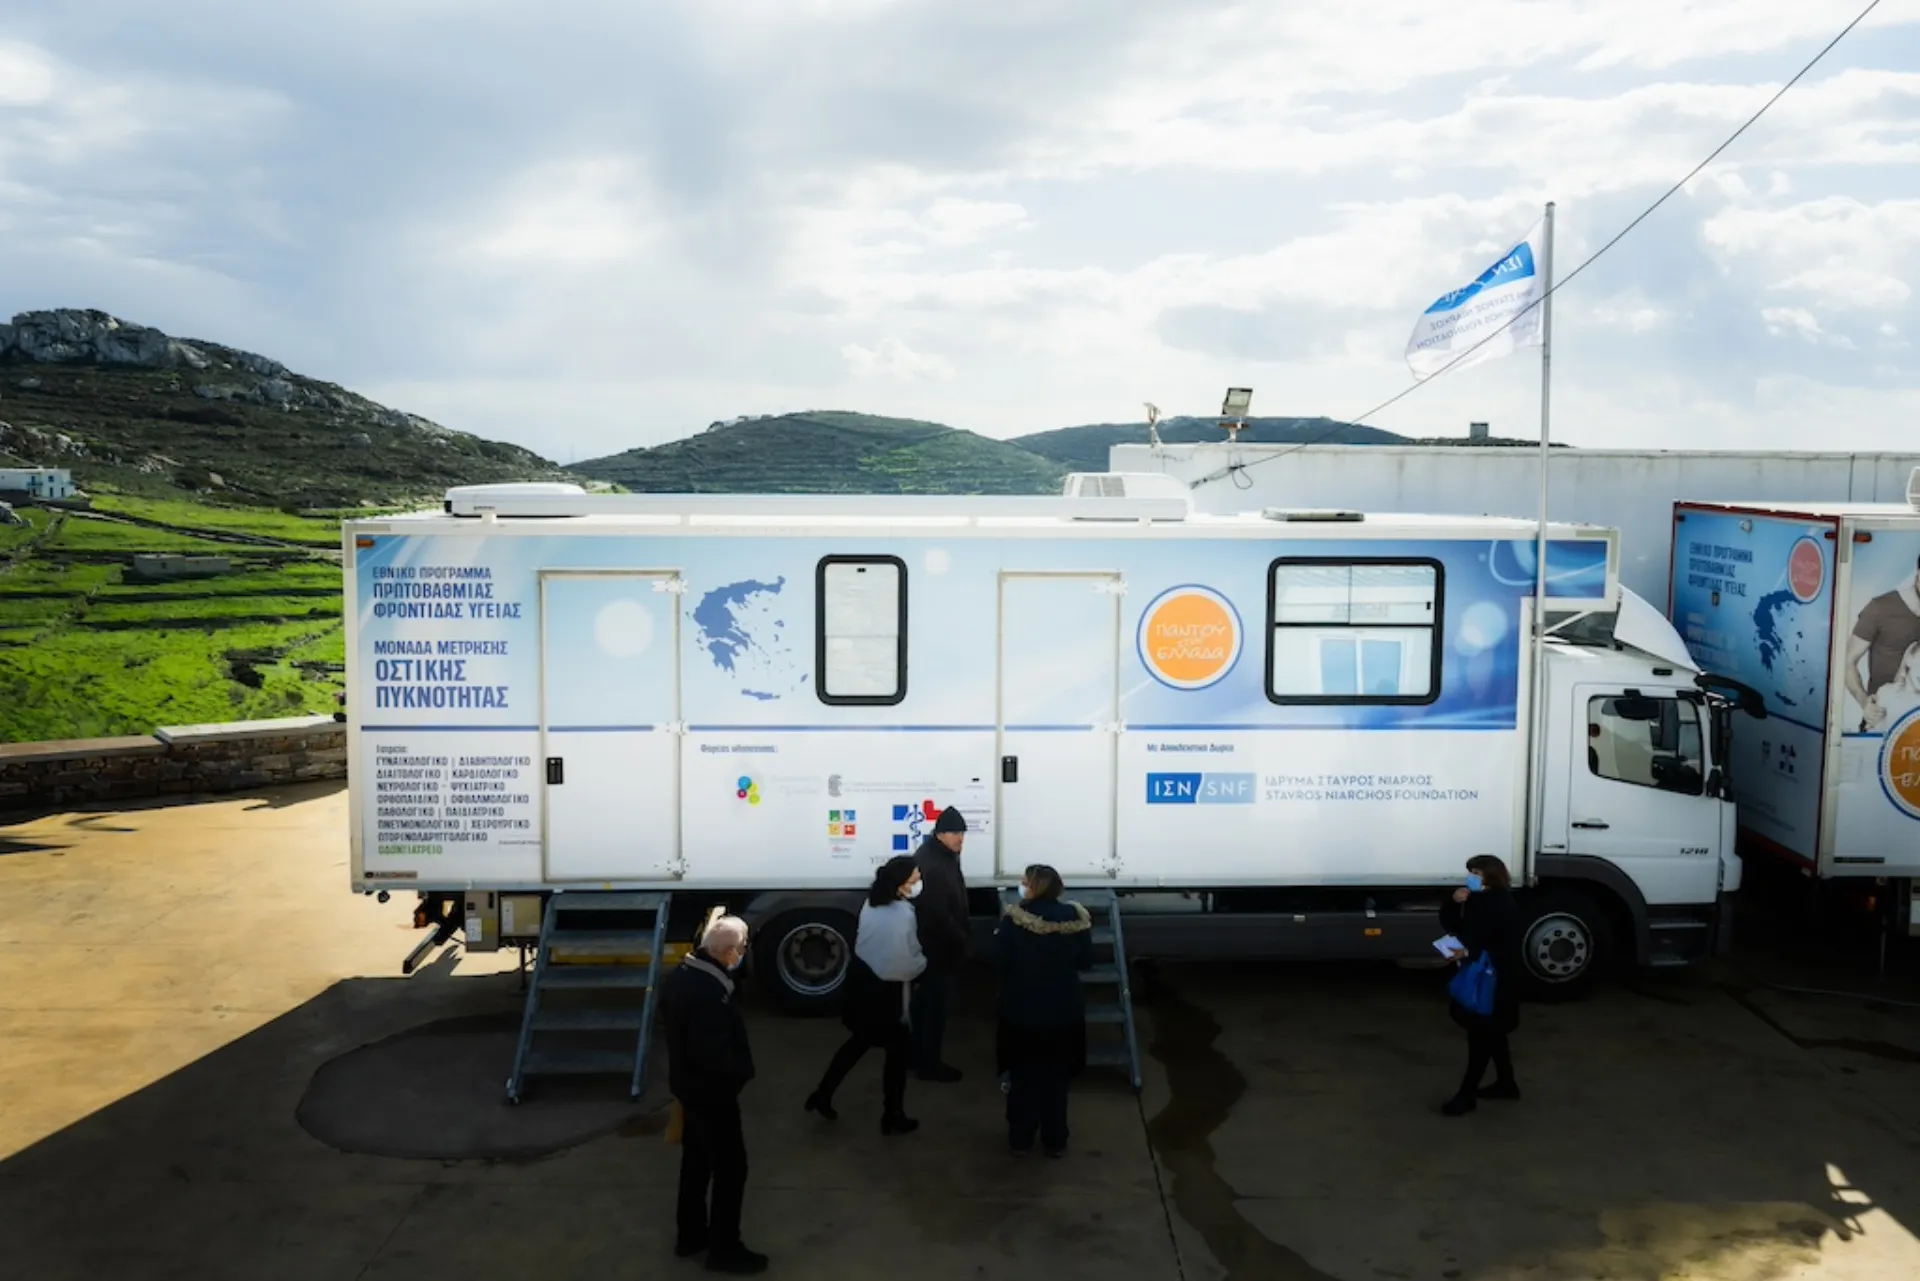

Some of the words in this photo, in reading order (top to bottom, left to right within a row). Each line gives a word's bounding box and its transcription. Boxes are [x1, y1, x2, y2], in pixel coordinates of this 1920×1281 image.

[372, 567, 416, 578] ΕΘΝΙΚΟ
[420, 567, 491, 578] ΠΡΟΓΡΑΜΜΑ
[373, 582, 494, 599] ΠΡΩΤΟΒΑΘΜΙΑΣ
[374, 602, 463, 618] ΦΡΟΝΤΙΔΑΣ
[469, 602, 521, 619] ΥΓΕΙΑΣ
[374, 641, 432, 655] ΜΟΝΑΔΑ
[437, 641, 508, 655] ΜΕΤΡΗΣΗΣ
[375, 659, 466, 682] ΟΣΤΙΚΗΣ
[376, 686, 509, 708] ΠΥΚΝΟΤΗΤΑΣ
[376, 756, 448, 766] ΓΥΝΑΙΚΟΛΟΓΙΚΟ
[452, 769, 518, 779] ΚΑΡΔΙΟΛΟΓΙΚΟ
[1265, 775, 1315, 786] ΙΔΡΥΜΑ
[1318, 775, 1376, 786] ΣΤΑΥΡΟΣ
[1378, 775, 1433, 786] ΝΙΑΡΧΟΣ
[377, 782, 439, 791] ΝΕΥΡΟΛΟΓΙΚΟ
[451, 782, 505, 791] ΨΥΧΙΑΤΡΙΚΟ
[1206, 780, 1249, 797] SNF
[377, 795, 439, 804] ΟΡΘΟΠΑΙΔΙΚΟ
[1265, 789, 1322, 800] STAVROS
[1325, 789, 1392, 800] NIARCHOS
[1394, 789, 1479, 800] FOUNDATION
[377, 807, 435, 817] ΠΑΘΟΛΟΓΙΚΟ
[446, 807, 505, 817] ΠΑΙΔΙΑΤΡΙΚΟ
